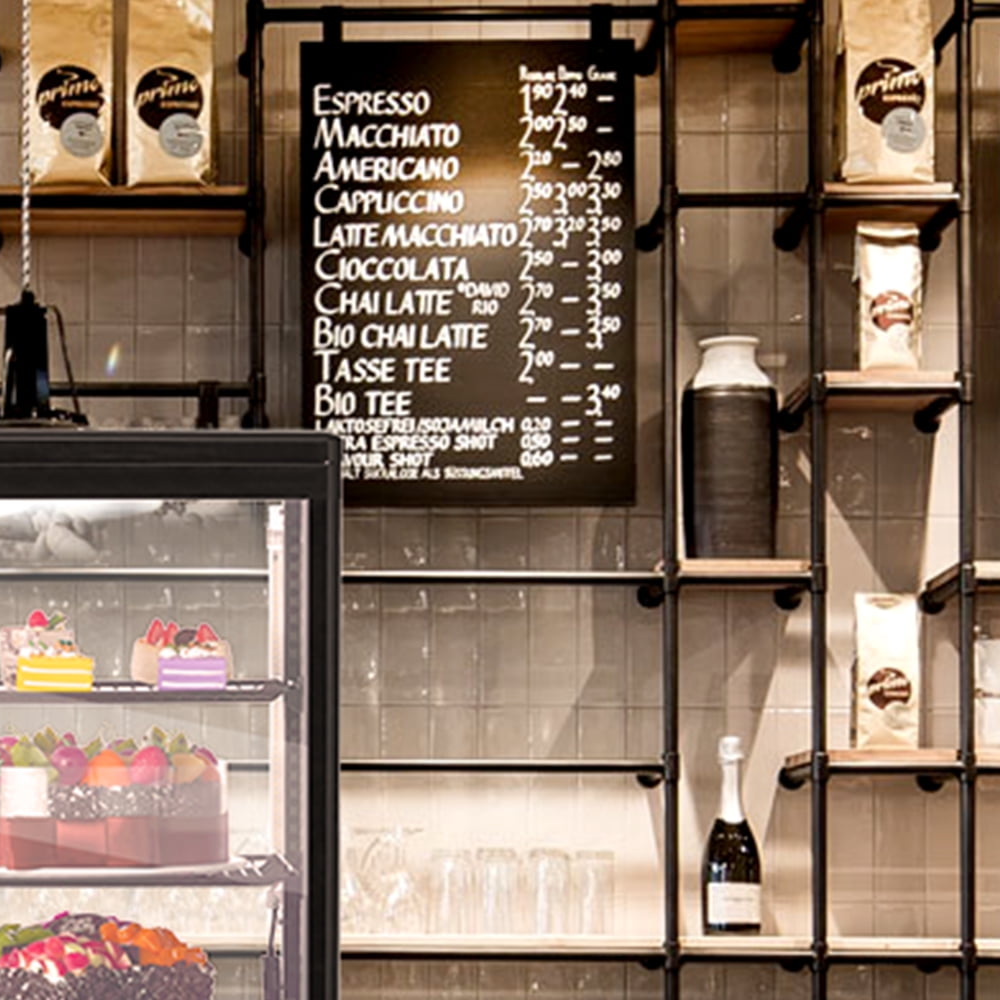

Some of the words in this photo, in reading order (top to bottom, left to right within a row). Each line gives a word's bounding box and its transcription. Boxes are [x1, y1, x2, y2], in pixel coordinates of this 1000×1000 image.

[314, 84, 430, 116] ESPRESSO
[314, 118, 460, 148] MACCHIATO
[314, 151, 460, 182] AMERICANO
[315, 185, 464, 214] CAPPUCCINO
[315, 218, 379, 247] LATTE
[382, 223, 517, 247] MACCHIATO
[316, 249, 469, 281] CIOCCOLATA
[314, 282, 380, 315] CHAI
[385, 289, 454, 316] LATTE
[314, 316, 355, 349] BIO
[360, 323, 416, 349] CHAI
[419, 323, 489, 350] LATTE
[314, 349, 396, 383] TASSE
[404, 357, 452, 383] TEE
[315, 383, 356, 416] BIO
[365, 390, 412, 416] TEE
[453, 433, 498, 452] SHOT
[389, 452, 434, 468] SHOT
